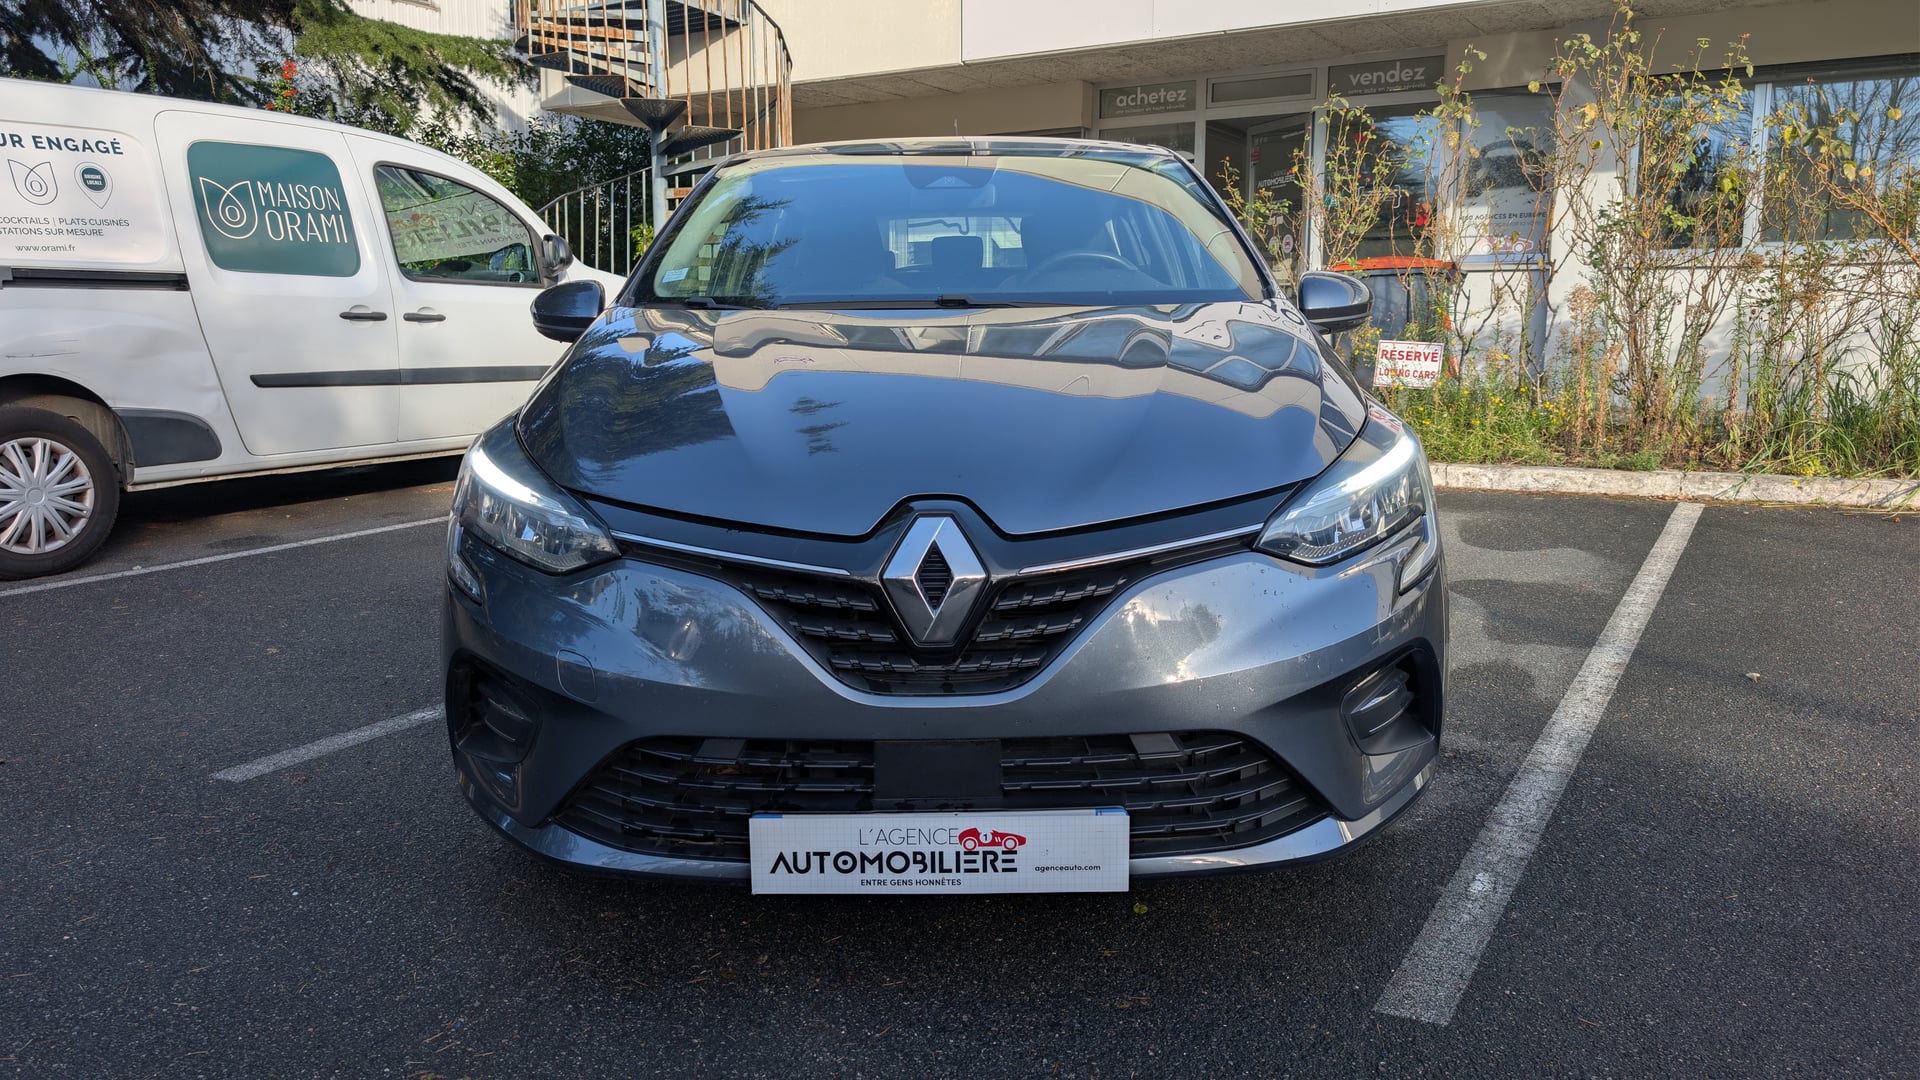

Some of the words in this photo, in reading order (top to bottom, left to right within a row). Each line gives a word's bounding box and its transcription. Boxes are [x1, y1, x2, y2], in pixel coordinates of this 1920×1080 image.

[1349, 61, 1426, 86] vendez
[1116, 87, 1187, 107] achetez
[32, 135, 124, 155] ENGAGÉ
[257, 180, 342, 212] MAISON
[58, 217, 87, 226] PLATS
[89, 217, 130, 227] CUISINÉS
[263, 209, 349, 244] ORAMI
[45, 228, 64, 236] SUR
[66, 228, 104, 237] MESURE
[15, 244, 76, 252] www.orami.fr
[1412, 369, 1437, 379] CARS
[859, 827, 959, 846] L'AGENCE
[1034, 864, 1102, 873] agenceauto.com
[860, 878, 888, 886] ENTRE
[889, 878, 914, 886] GENS
[915, 876, 962, 886] HONNÊTES
